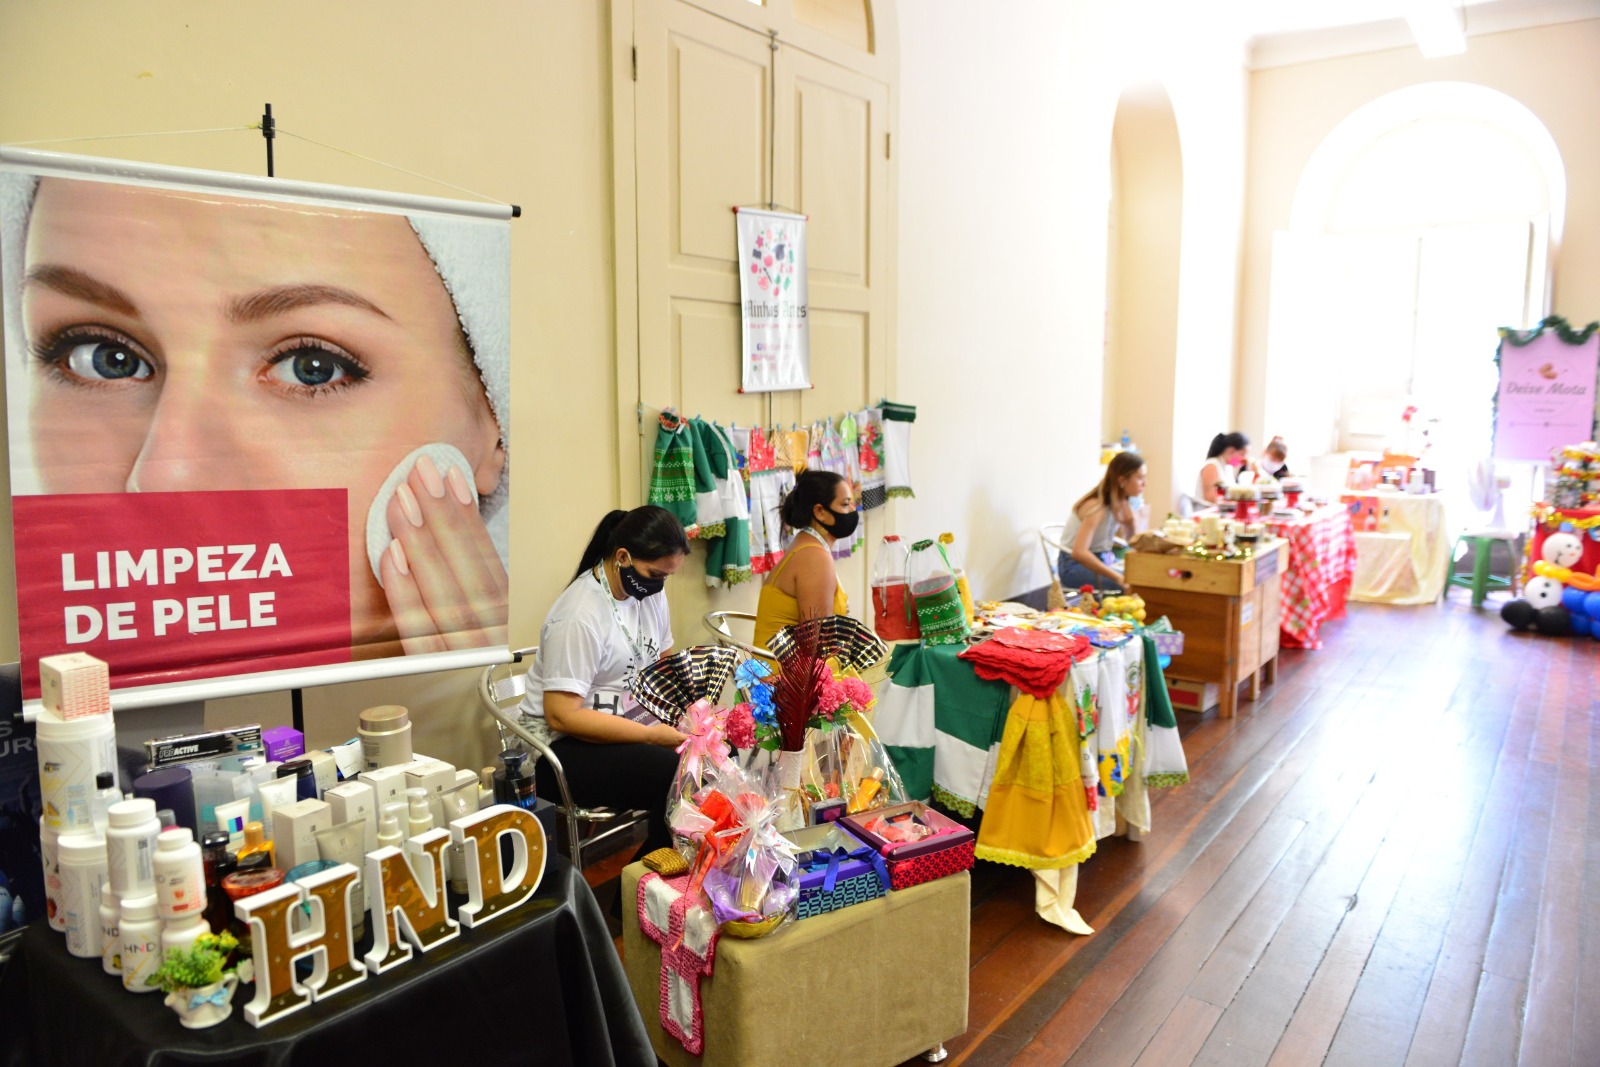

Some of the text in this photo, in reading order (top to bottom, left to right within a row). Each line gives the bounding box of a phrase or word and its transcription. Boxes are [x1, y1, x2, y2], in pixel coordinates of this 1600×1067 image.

[1506, 381, 1587, 395] Deise Mota
[61, 543, 293, 591] LIMPEZA
[627, 575, 648, 593] HND
[64, 592, 277, 644] DE PELE
[234, 804, 547, 1028] HND
[123, 941, 157, 953] HND
